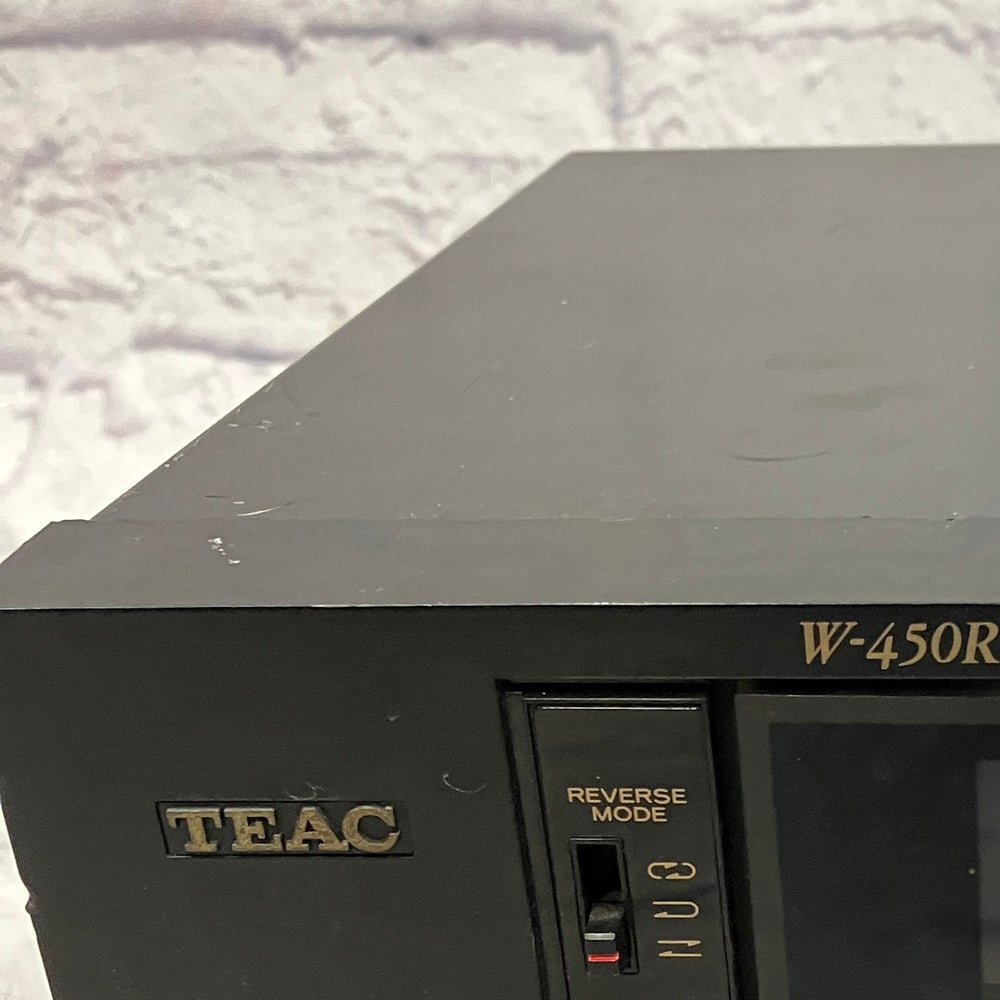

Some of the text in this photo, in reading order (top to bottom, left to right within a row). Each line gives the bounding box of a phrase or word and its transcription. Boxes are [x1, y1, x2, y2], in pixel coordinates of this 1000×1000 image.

[800, 621, 1000, 670] W-450R
[567, 787, 688, 804] REVERSE
[166, 806, 400, 852] TEAC
[592, 805, 668, 822] MODE
